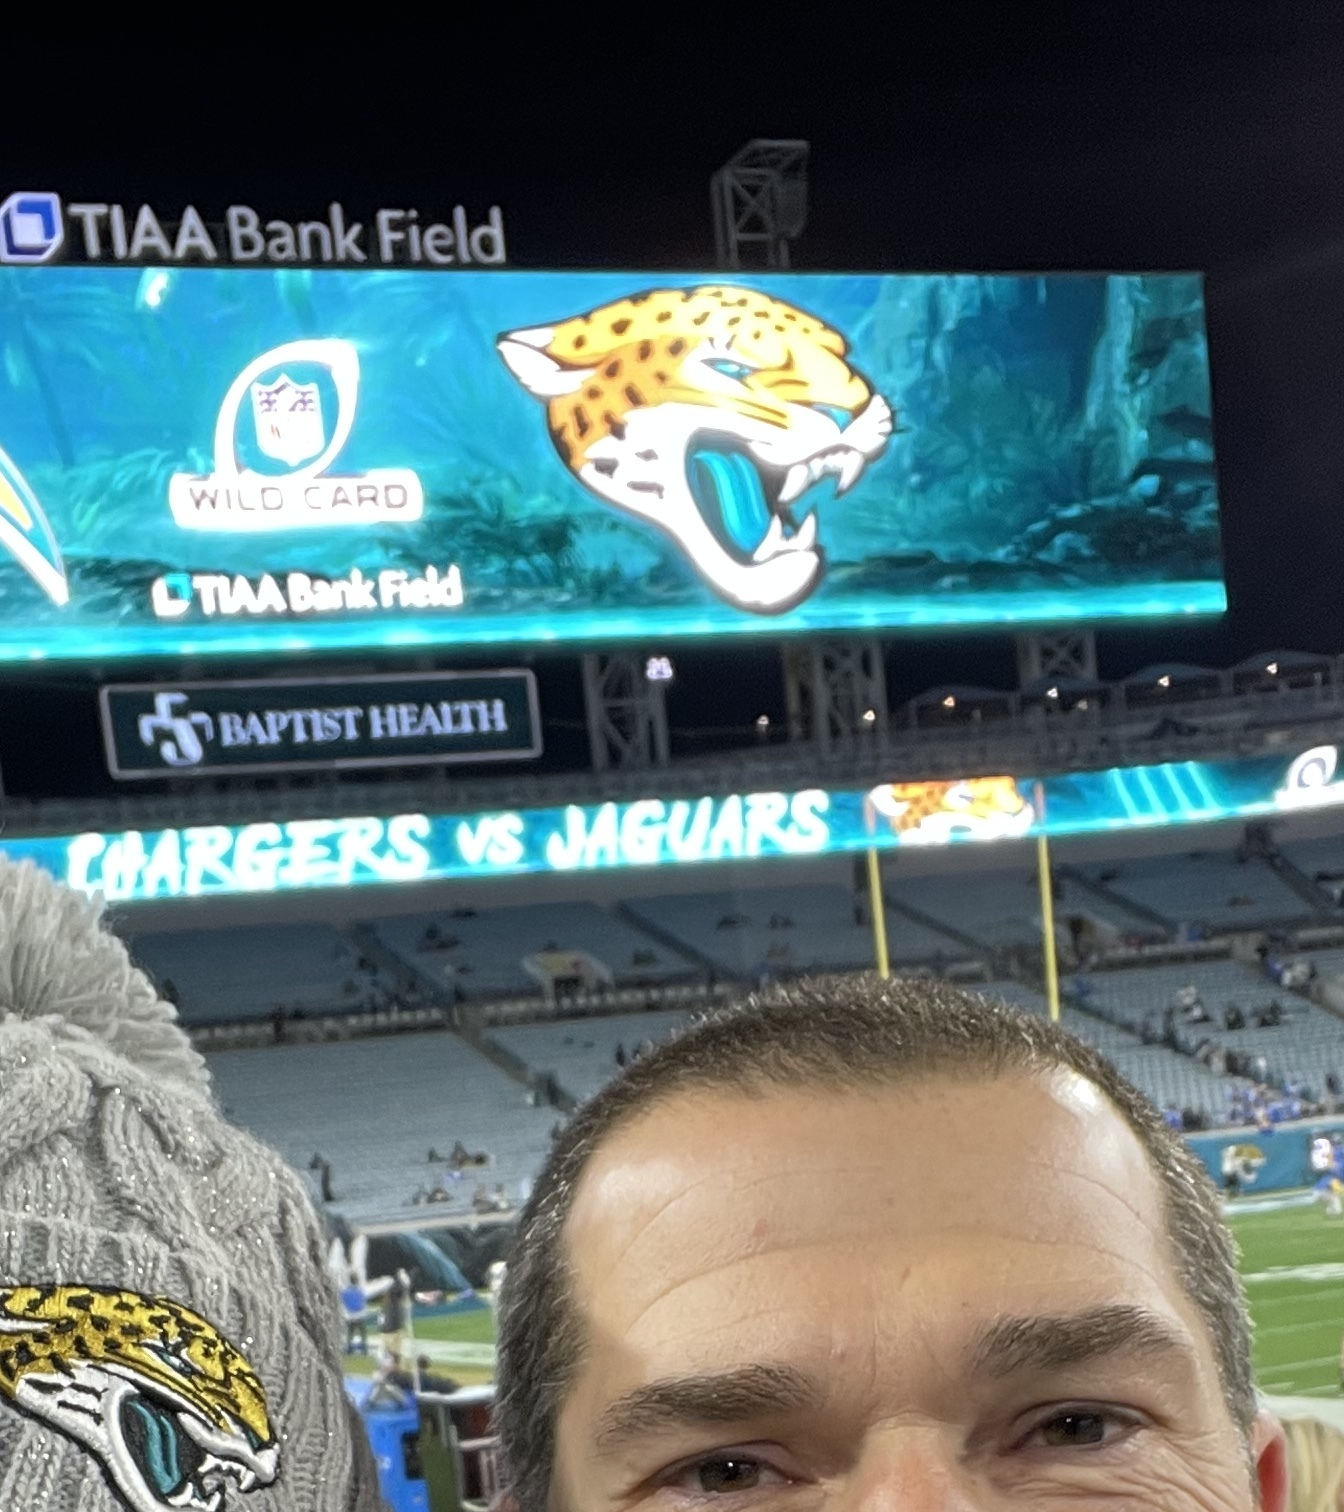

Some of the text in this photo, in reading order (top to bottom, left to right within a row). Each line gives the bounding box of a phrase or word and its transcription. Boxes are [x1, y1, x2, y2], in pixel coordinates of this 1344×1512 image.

[68, 202, 507, 264] TIAA Bank Field
[188, 484, 409, 511] WILD CARD
[192, 565, 464, 616] TIAA Bank Field
[219, 698, 508, 748] BAPTIST HEALTH
[66, 813, 430, 900] CHARGERS
[546, 788, 831, 869] JAGUARS
